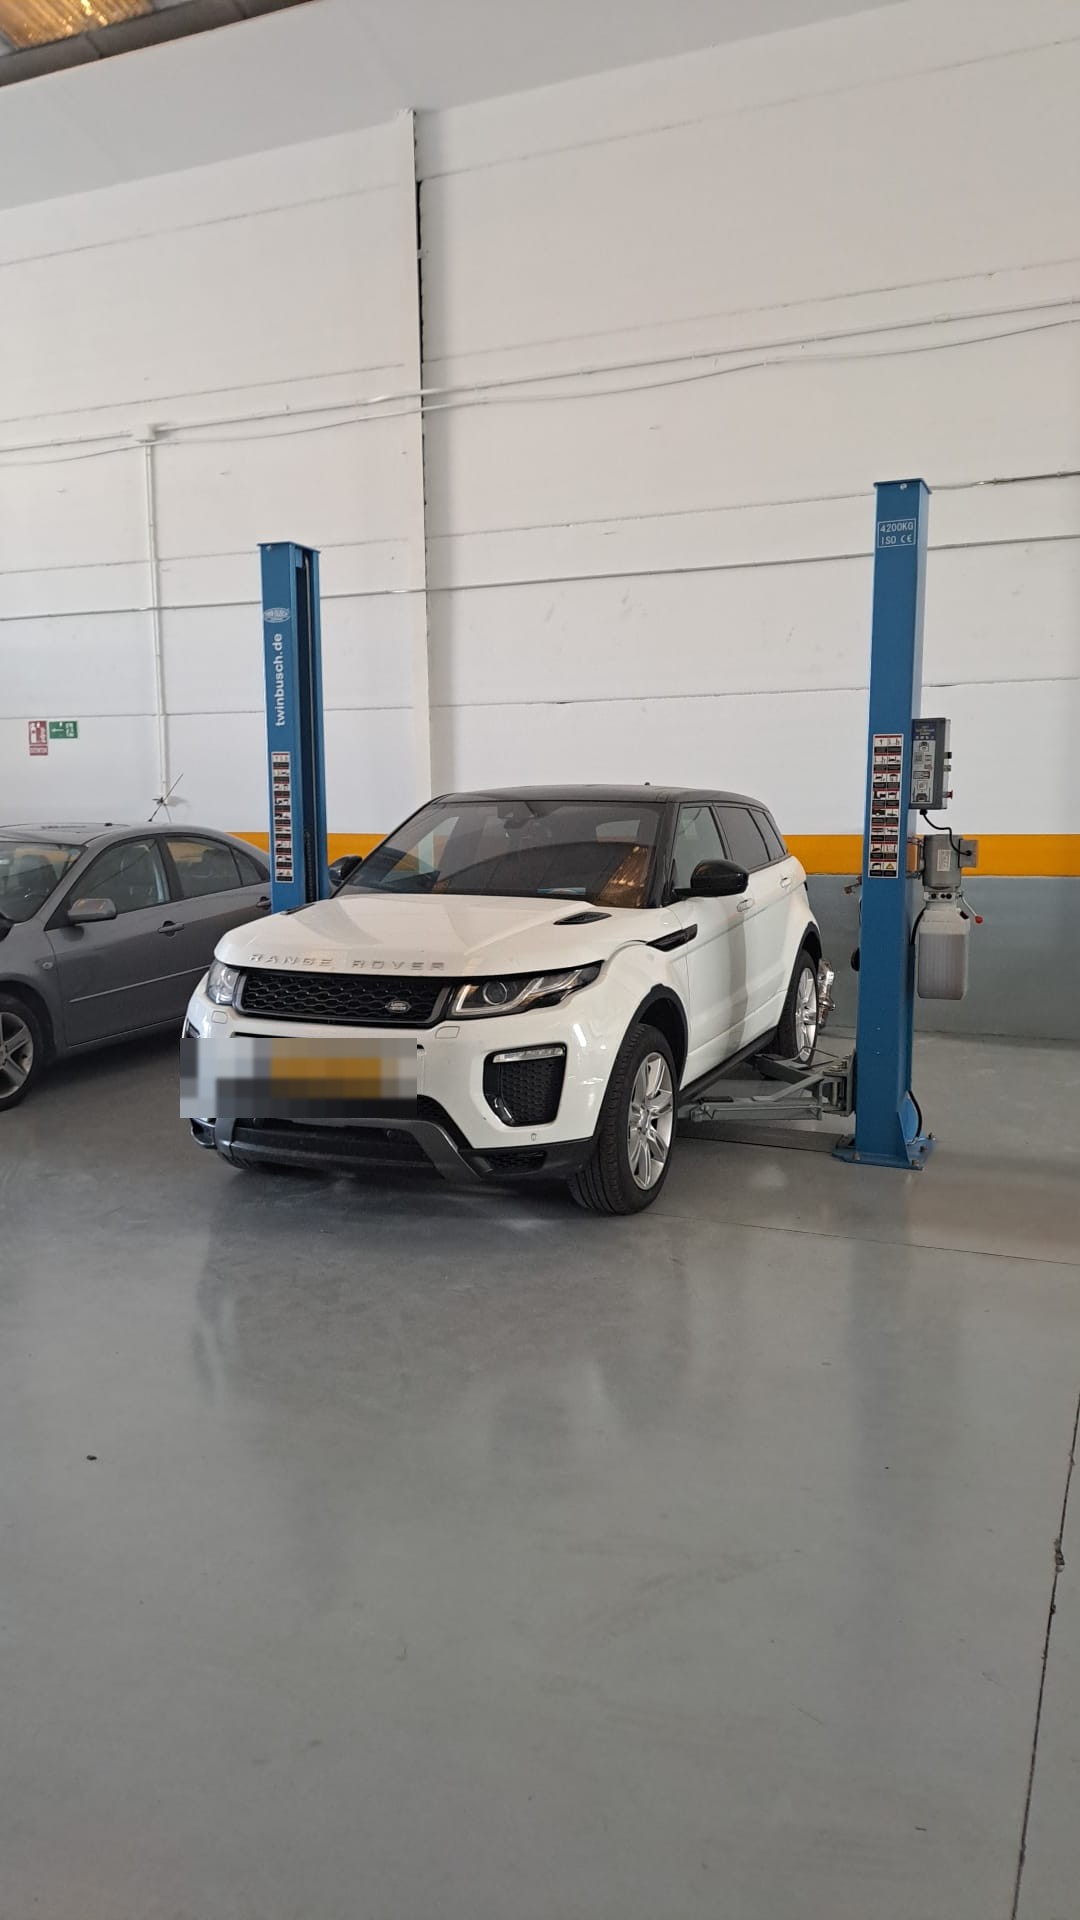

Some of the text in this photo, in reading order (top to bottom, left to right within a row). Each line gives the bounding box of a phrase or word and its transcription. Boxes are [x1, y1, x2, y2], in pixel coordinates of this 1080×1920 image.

[880, 521, 914, 532] 4200KG
[881, 535, 897, 545] ISO
[272, 633, 285, 726] twinbusch.de
[249, 953, 445, 971] RANGE ROVER
